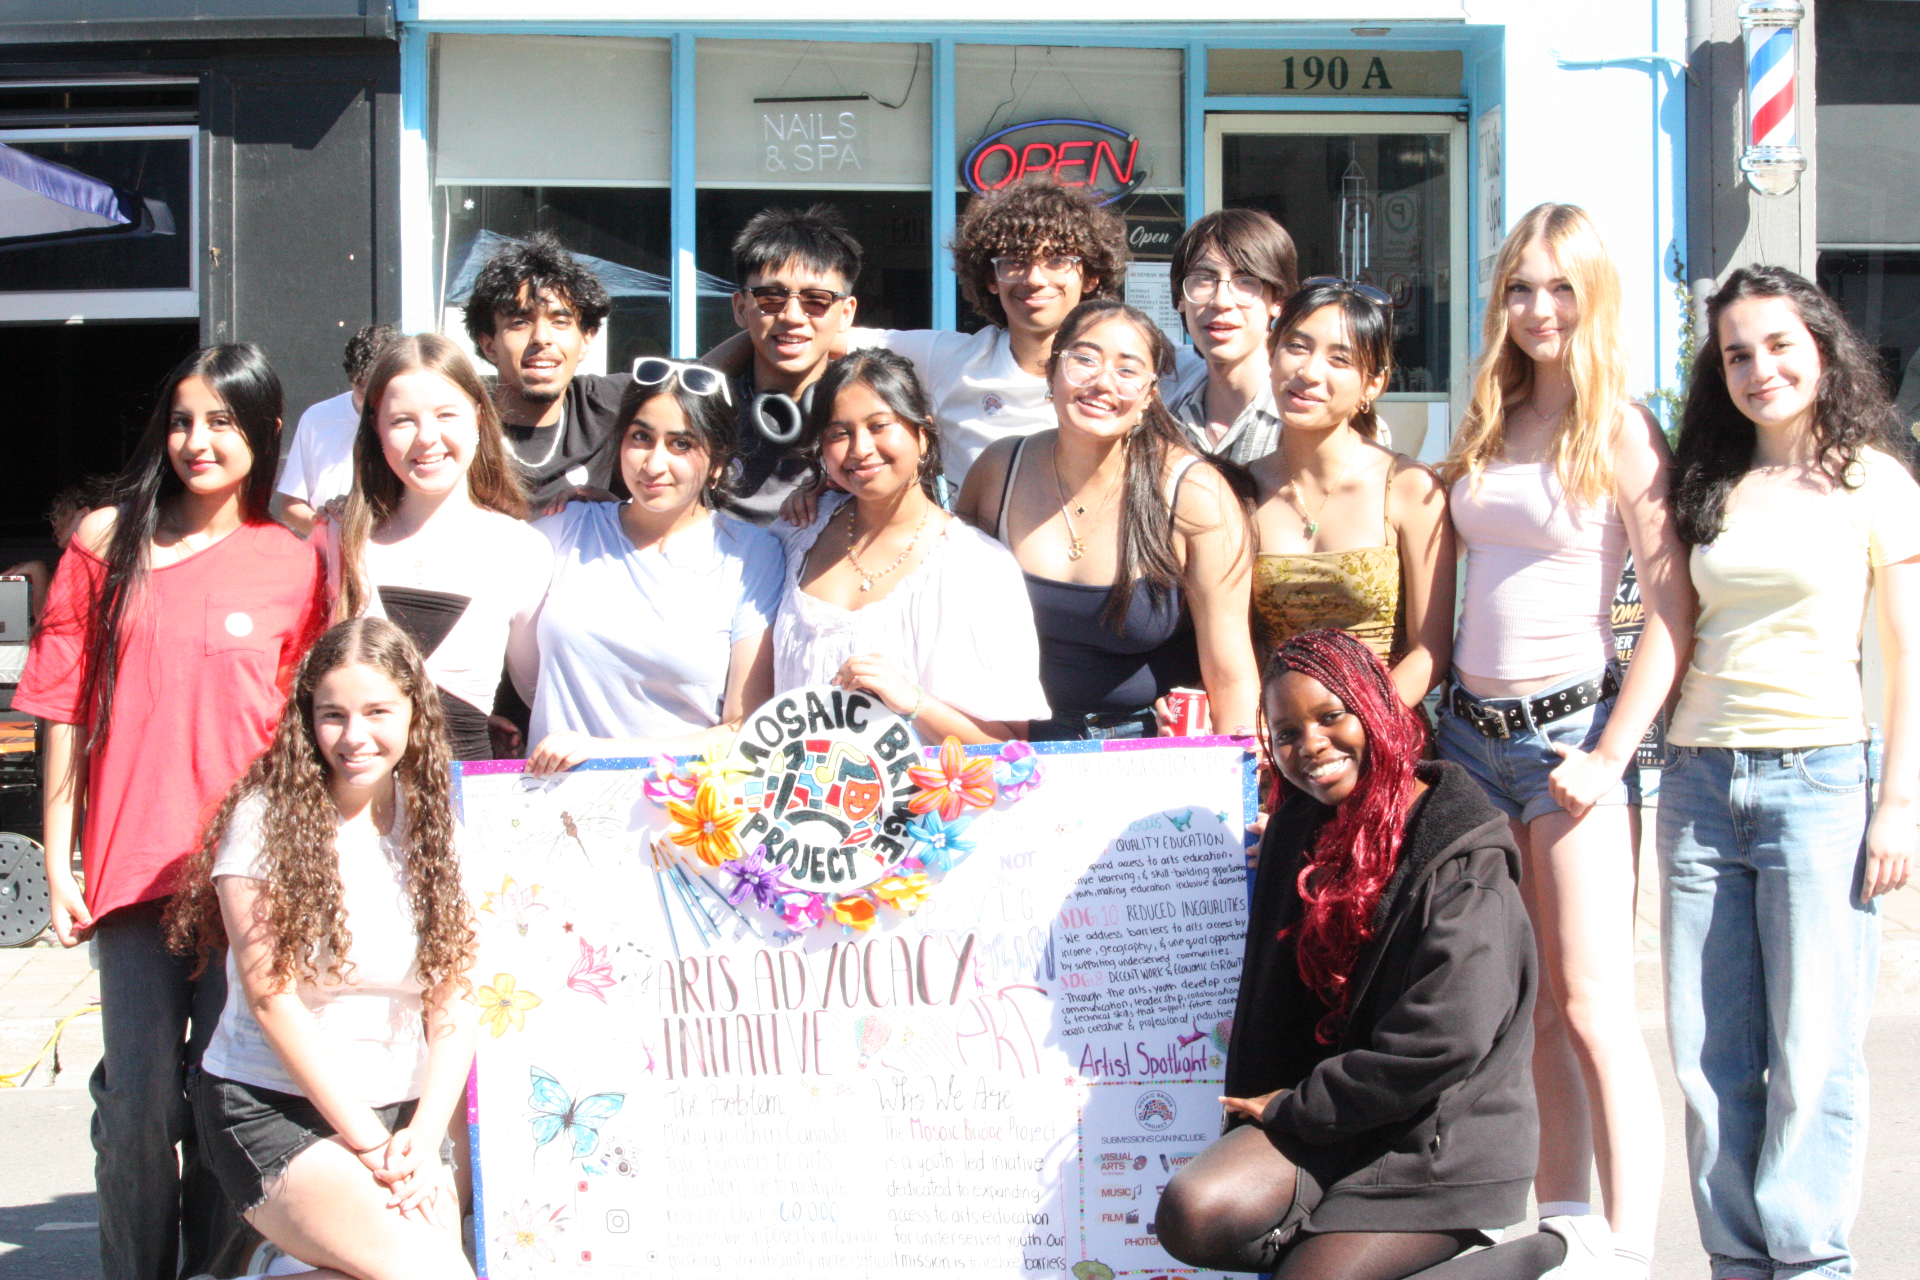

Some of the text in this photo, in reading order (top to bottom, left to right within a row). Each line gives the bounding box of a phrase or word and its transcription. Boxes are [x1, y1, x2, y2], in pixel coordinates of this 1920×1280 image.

[1281, 56, 1393, 90] 190 A
[763, 111, 857, 140] NAILS
[766, 144, 861, 171] & SPA
[973, 138, 1139, 190] OPEN
[1129, 226, 1172, 248] Open
[739, 690, 872, 778] MOSAIC
[1097, 752, 1197, 780] CONNECTION
[1128, 814, 1163, 832] oals
[740, 810, 859, 884] PROJECT
[1115, 832, 1225, 852] QUALITY EDUCATION
[1000, 850, 1037, 872] NOT
[1117, 859, 1145, 869] access
[1147, 854, 1158, 866] to
[1160, 853, 1179, 865] arts
[1096, 886, 1127, 898] making
[1130, 882, 1171, 894] education
[1176, 877, 1210, 889] inclusive
[1060, 906, 1099, 930] SDG
[1126, 901, 1177, 922] REDUCED
[1181, 897, 1246, 918] INEQUALITIES
[1085, 929, 1123, 940] address
[1127, 925, 1169, 937] barriers
[1172, 922, 1182, 933] to
[1185, 919, 1203, 931] arts
[1206, 920, 1233, 930] access
[1235, 918, 1246, 928] by
[1168, 937, 1208, 951] unequal
[659, 932, 976, 1015] ARTS ADVOCACY
[1060, 961, 1072, 972] by
[1075, 958, 1117, 970] supporting
[1118, 953, 1170, 967] underserved
[1060, 971, 1094, 990] SDG
[1108, 967, 1140, 984] DECENT
[1141, 965, 1164, 980] WORK
[1174, 962, 1208, 976] ECONOMIC
[1106, 987, 1125, 998] the
[1153, 980, 1177, 994] youth
[1181, 976, 1220, 989] develop
[1187, 987, 1239, 1000] collaboration
[1062, 1027, 1086, 1037] across
[1087, 1022, 1124, 1034] creative
[1139, 1013, 1189, 1028] professional
[1192, 1008, 1233, 1022] industrie
[1074, 1012, 1111, 1025] technical
[1113, 1008, 1135, 1019] skills
[1136, 1007, 1156, 1018] that
[1158, 1002, 1187, 1015] support
[1189, 998, 1213, 1011] future
[956, 983, 1050, 1079] ART
[1079, 1041, 1208, 1081] Artist Spotlight
[664, 1083, 785, 1118] The Problem
[872, 1074, 1013, 1111] Who We Are
[1137, 1092, 1174, 1110] MOSAIC BRIDGE
[663, 1122, 709, 1153] Many
[714, 1116, 761, 1153] youth
[786, 1116, 848, 1145] Canada
[882, 1115, 906, 1142] The
[910, 1117, 961, 1142] Mosaic
[964, 1118, 1004, 1145] Bridge
[1144, 1122, 1168, 1130] PROJECT
[1101, 1134, 1155, 1145] SUBMISSIONS
[1154, 1134, 1173, 1143] CAN
[665, 1145, 834, 1174] face barriers to arts
[885, 1155, 898, 1171] is
[901, 1155, 913, 1170] a
[1100, 1152, 1134, 1162] VISUAL
[1101, 1162, 1126, 1171] ARTS
[665, 1174, 848, 1200] education due to multiple
[887, 1176, 1041, 1204] dedicated to expanding
[1101, 1188, 1132, 1198] MUSIC
[666, 1207, 726, 1225] reasons
[731, 1200, 766, 1224] Over
[888, 1203, 1050, 1226] access to arts education
[1102, 1213, 1124, 1223] FILM
[667, 1225, 721, 1248] Children
[750, 1230, 763, 1245] in
[821, 1229, 833, 1244] in
[835, 1223, 879, 1245] Canada
[894, 1225, 912, 1245] for
[916, 1228, 1002, 1246] underserved
[1046, 1233, 1066, 1247] Our
[668, 1248, 899, 1273] making significantly more difficult
[901, 1251, 1067, 1271] mission is to reduce barriers
